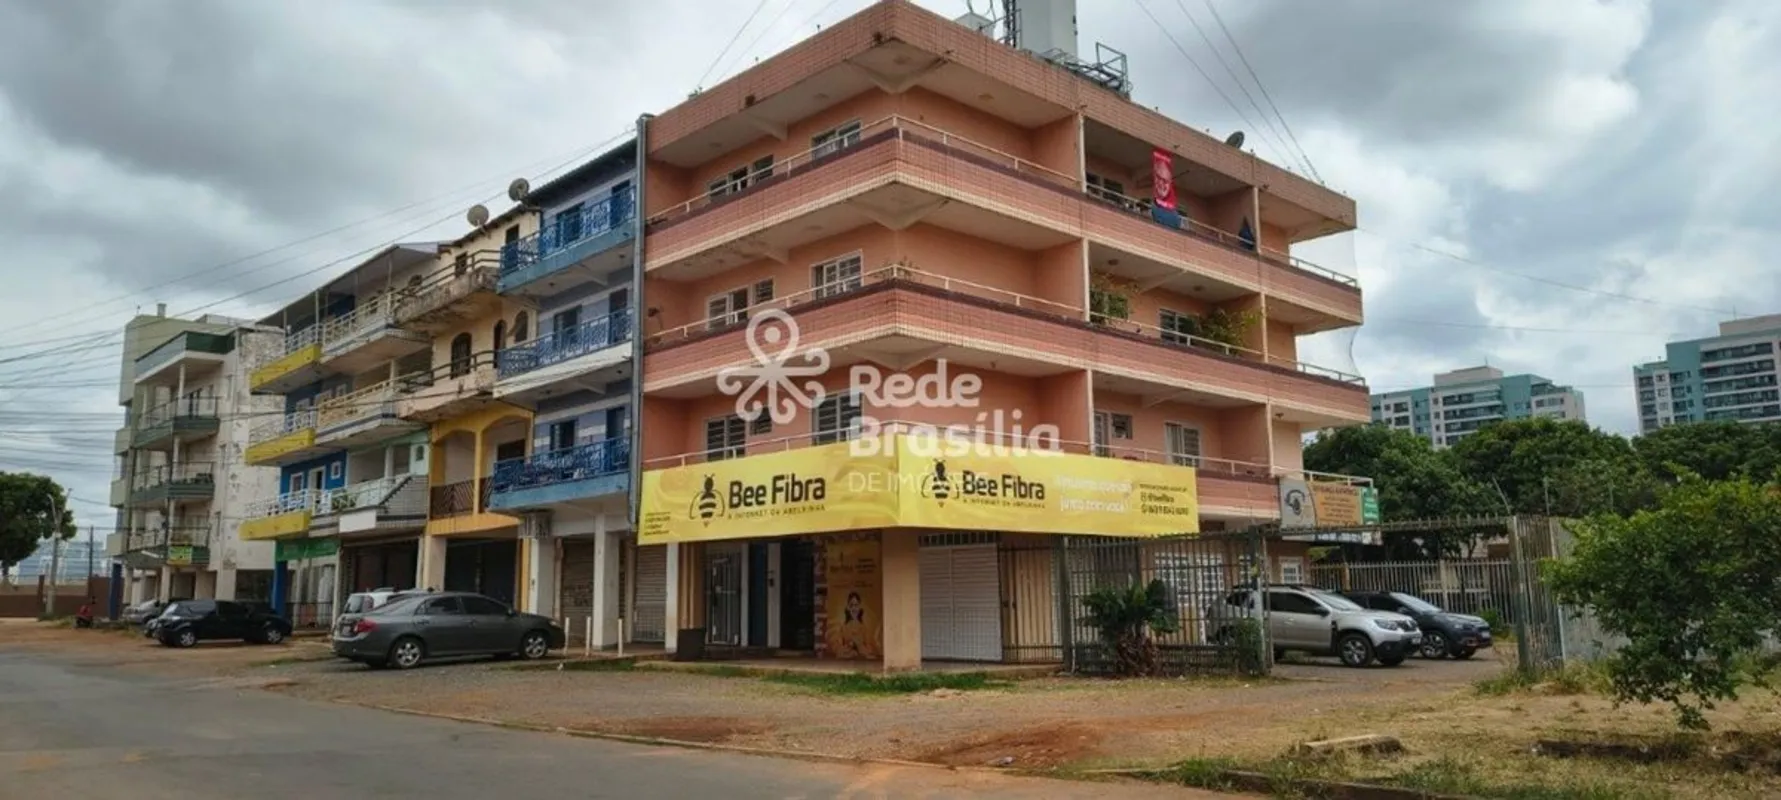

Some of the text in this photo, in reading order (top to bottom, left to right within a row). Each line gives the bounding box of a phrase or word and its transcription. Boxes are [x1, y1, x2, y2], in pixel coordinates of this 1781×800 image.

[729, 473, 826, 509] Bee Fibra
[962, 470, 998, 497] Bee
[1002, 474, 1045, 500] Fibra
